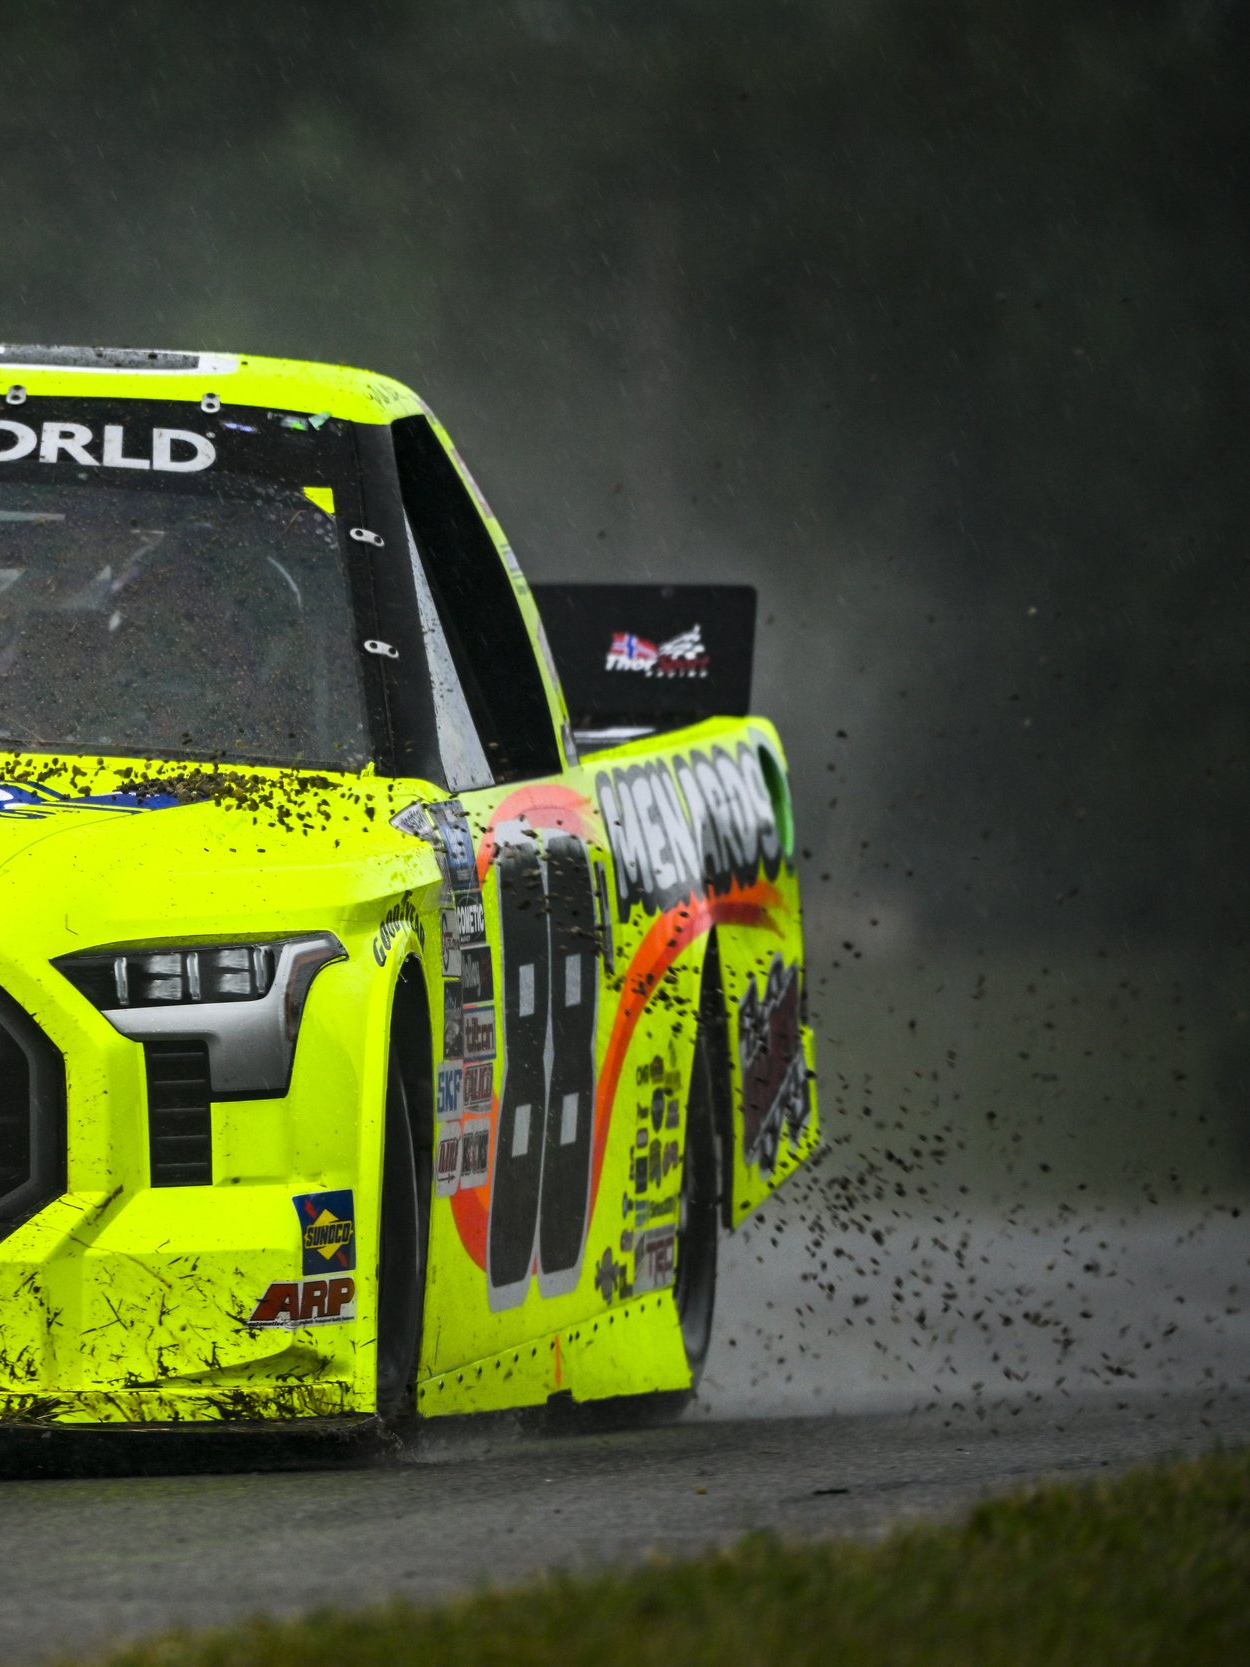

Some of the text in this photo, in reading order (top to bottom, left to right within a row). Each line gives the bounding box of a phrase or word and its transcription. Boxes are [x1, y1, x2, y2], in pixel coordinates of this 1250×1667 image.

[373, 890, 425, 967] GOODYEAR
[487, 817, 597, 1313] 88
[437, 1068, 462, 1114] SKF
[306, 1221, 351, 1248] SUNOCO
[248, 1277, 356, 1323] ARP
